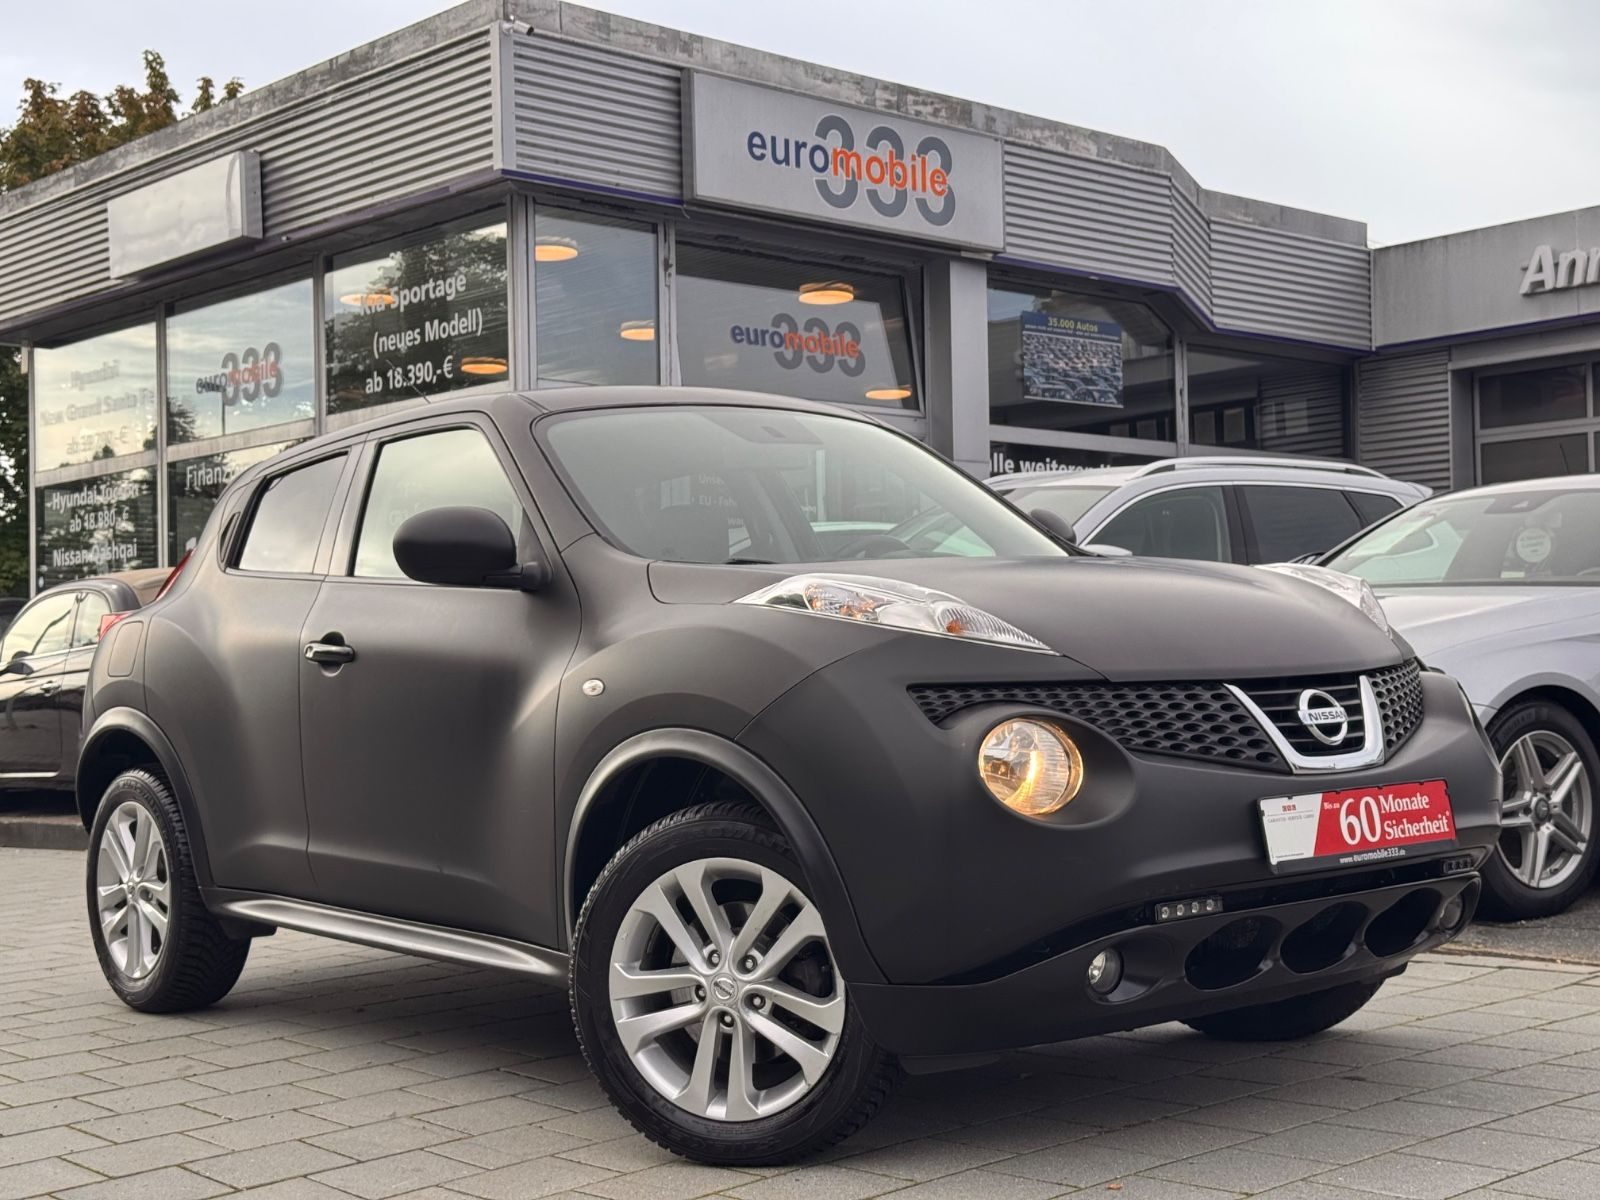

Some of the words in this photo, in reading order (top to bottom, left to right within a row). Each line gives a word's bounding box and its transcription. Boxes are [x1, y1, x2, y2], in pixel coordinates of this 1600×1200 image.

[747, 131, 947, 197] euromobile
[390, 273, 467, 312] Sportage
[373, 329, 420, 358] (neues
[424, 308, 482, 342] Modell)
[1076, 321, 1098, 332] Autos
[365, 370, 383, 394] ab
[990, 452, 1015, 473] lle
[52, 485, 97, 514] Hyundai
[69, 514, 82, 533] ab
[52, 547, 89, 568] Nissan
[1308, 710, 1347, 721] NISSAN
[1339, 795, 1382, 846] 60
[1378, 791, 1430, 814] Monate
